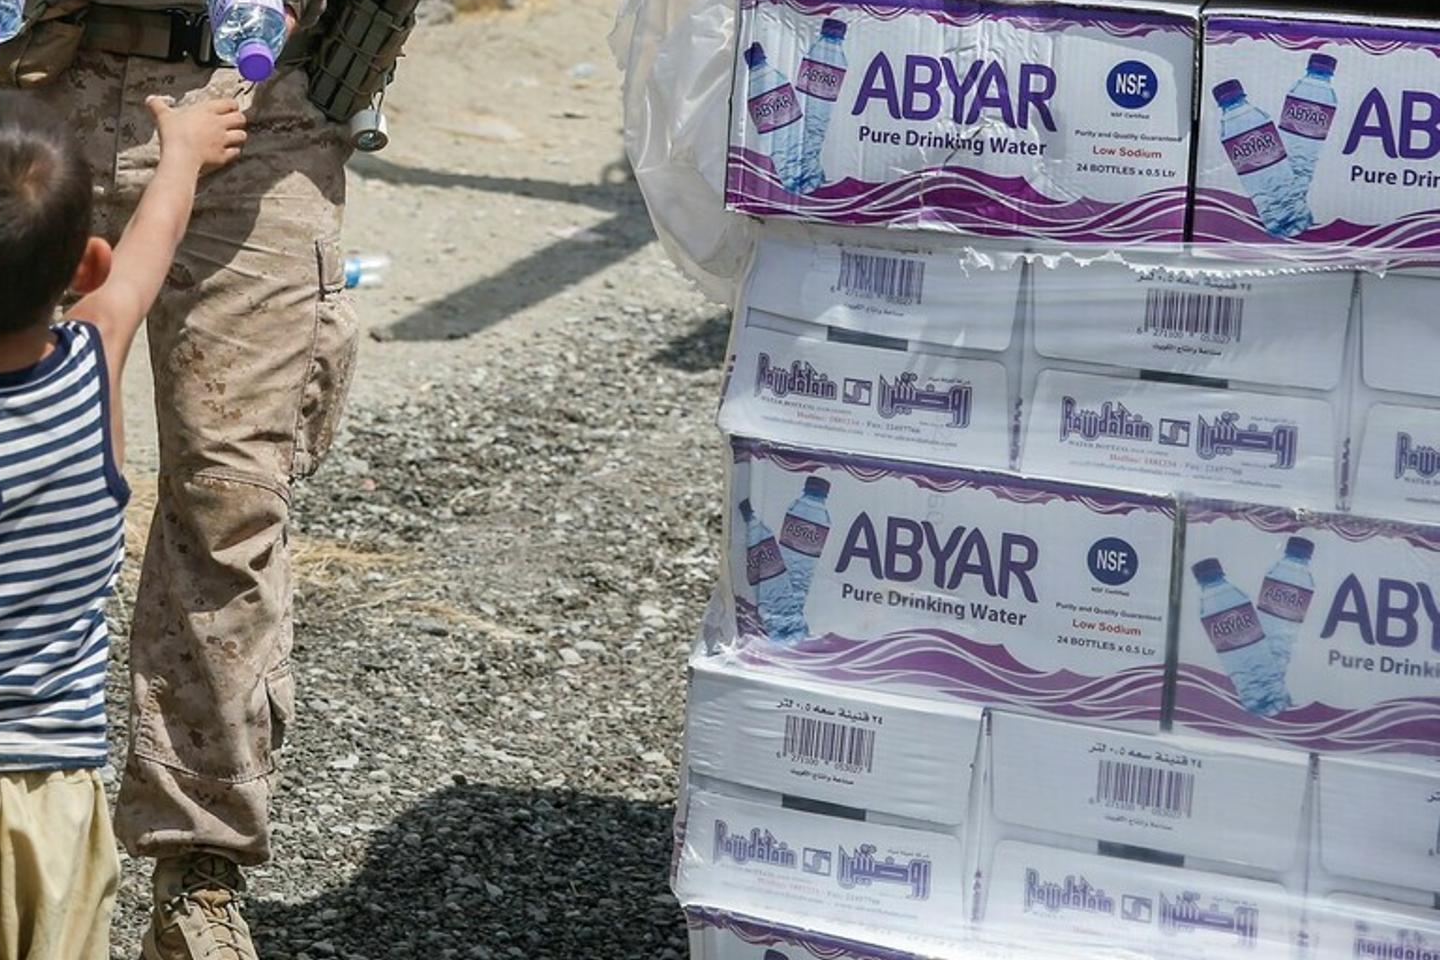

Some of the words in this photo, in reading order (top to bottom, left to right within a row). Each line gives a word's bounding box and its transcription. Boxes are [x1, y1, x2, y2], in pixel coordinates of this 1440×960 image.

[851, 51, 1057, 132] ABYAR
[1115, 72, 1148, 96] NSF
[1286, 105, 1328, 127] ABYAR
[860, 125, 901, 146] Pure
[905, 129, 984, 155] Drinking
[990, 137, 1047, 156] Water
[1075, 129, 1097, 138] Purity
[1113, 131, 1138, 141] Quality
[1092, 145, 1116, 156] Low
[1119, 146, 1162, 159] Sodium
[1231, 133, 1277, 160] ABYAR
[1076, 163, 1088, 173] 24
[1090, 164, 1136, 176] BOTTLES
[1145, 168, 1160, 177] 0.5
[1162, 169, 1176, 178] Ltr
[1350, 165, 1398, 185] Pure
[835, 511, 1038, 603] ABYAR
[1096, 549, 1128, 572] NSF
[842, 583, 884, 605] Pure
[887, 590, 966, 620] Drinking
[969, 602, 1027, 626] Water
[1056, 602, 1077, 611] Purity
[1078, 605, 1092, 613] and
[1094, 607, 1118, 617] Quality
[1072, 618, 1096, 630] Low
[1098, 622, 1142, 636] Sodium
[1212, 615, 1257, 640] ABYAR
[1057, 635, 1068, 644] 24
[1070, 637, 1116, 651] BOTTLES
[1125, 644, 1140, 654] 0.5
[1142, 646, 1156, 656] Ltr
[1328, 650, 1375, 671] Pure
